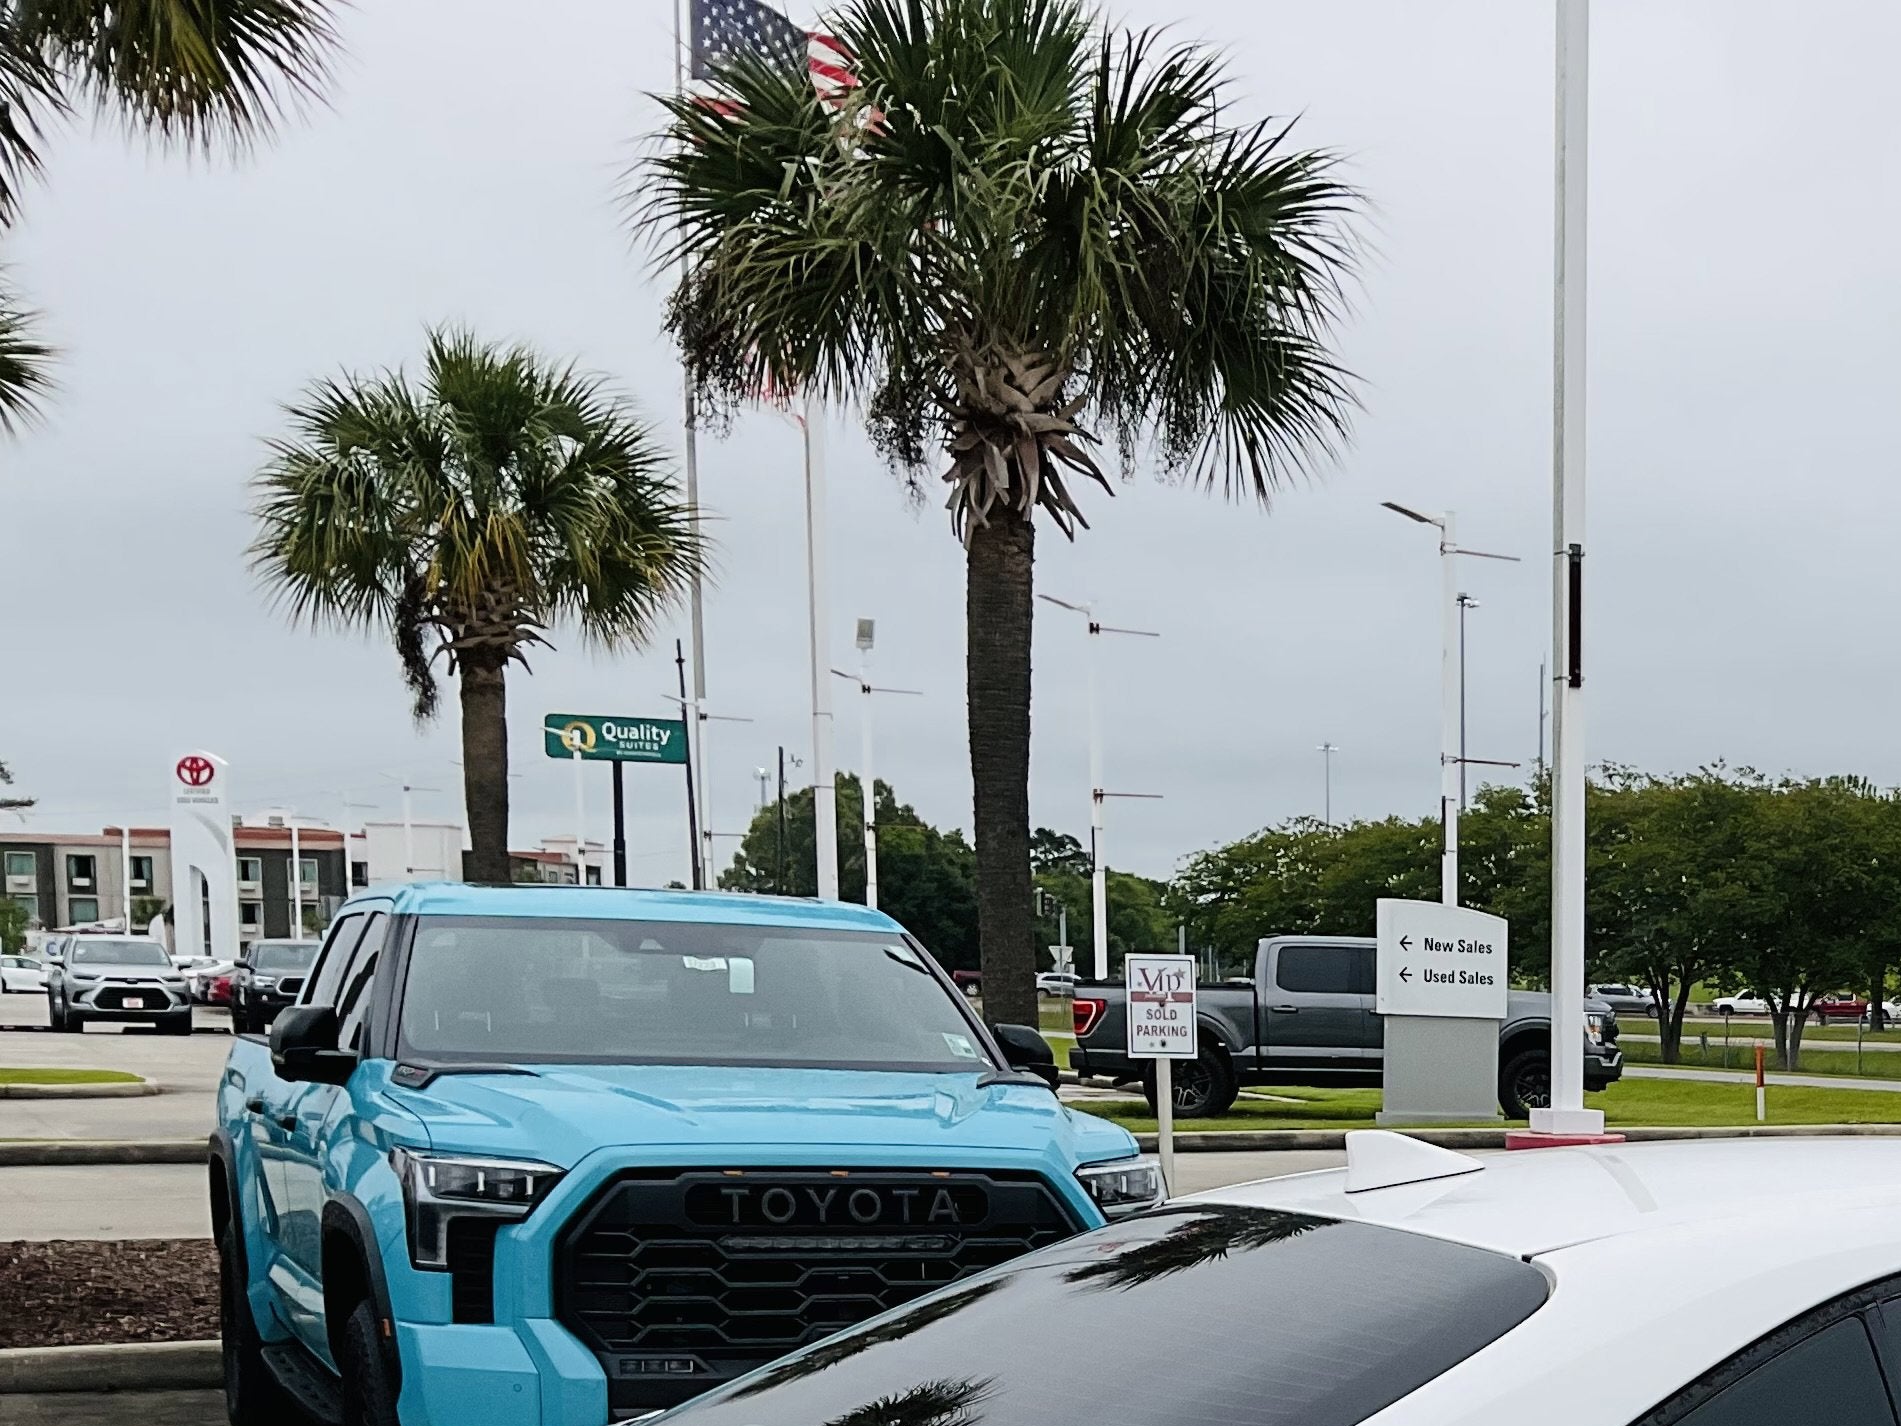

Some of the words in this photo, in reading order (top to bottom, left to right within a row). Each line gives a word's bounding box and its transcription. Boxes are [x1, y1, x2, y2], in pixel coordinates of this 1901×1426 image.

[601, 721, 671, 745] Quality
[619, 740, 660, 751] SUITES
[1424, 937, 1454, 952] New
[1457, 939, 1493, 954] Sales
[1423, 968, 1455, 984] Used
[1458, 970, 1494, 985] Sales
[1145, 1008, 1177, 1020] SOLD
[1136, 1025, 1188, 1037] PARKING
[720, 1187, 962, 1224] TOYOTA
